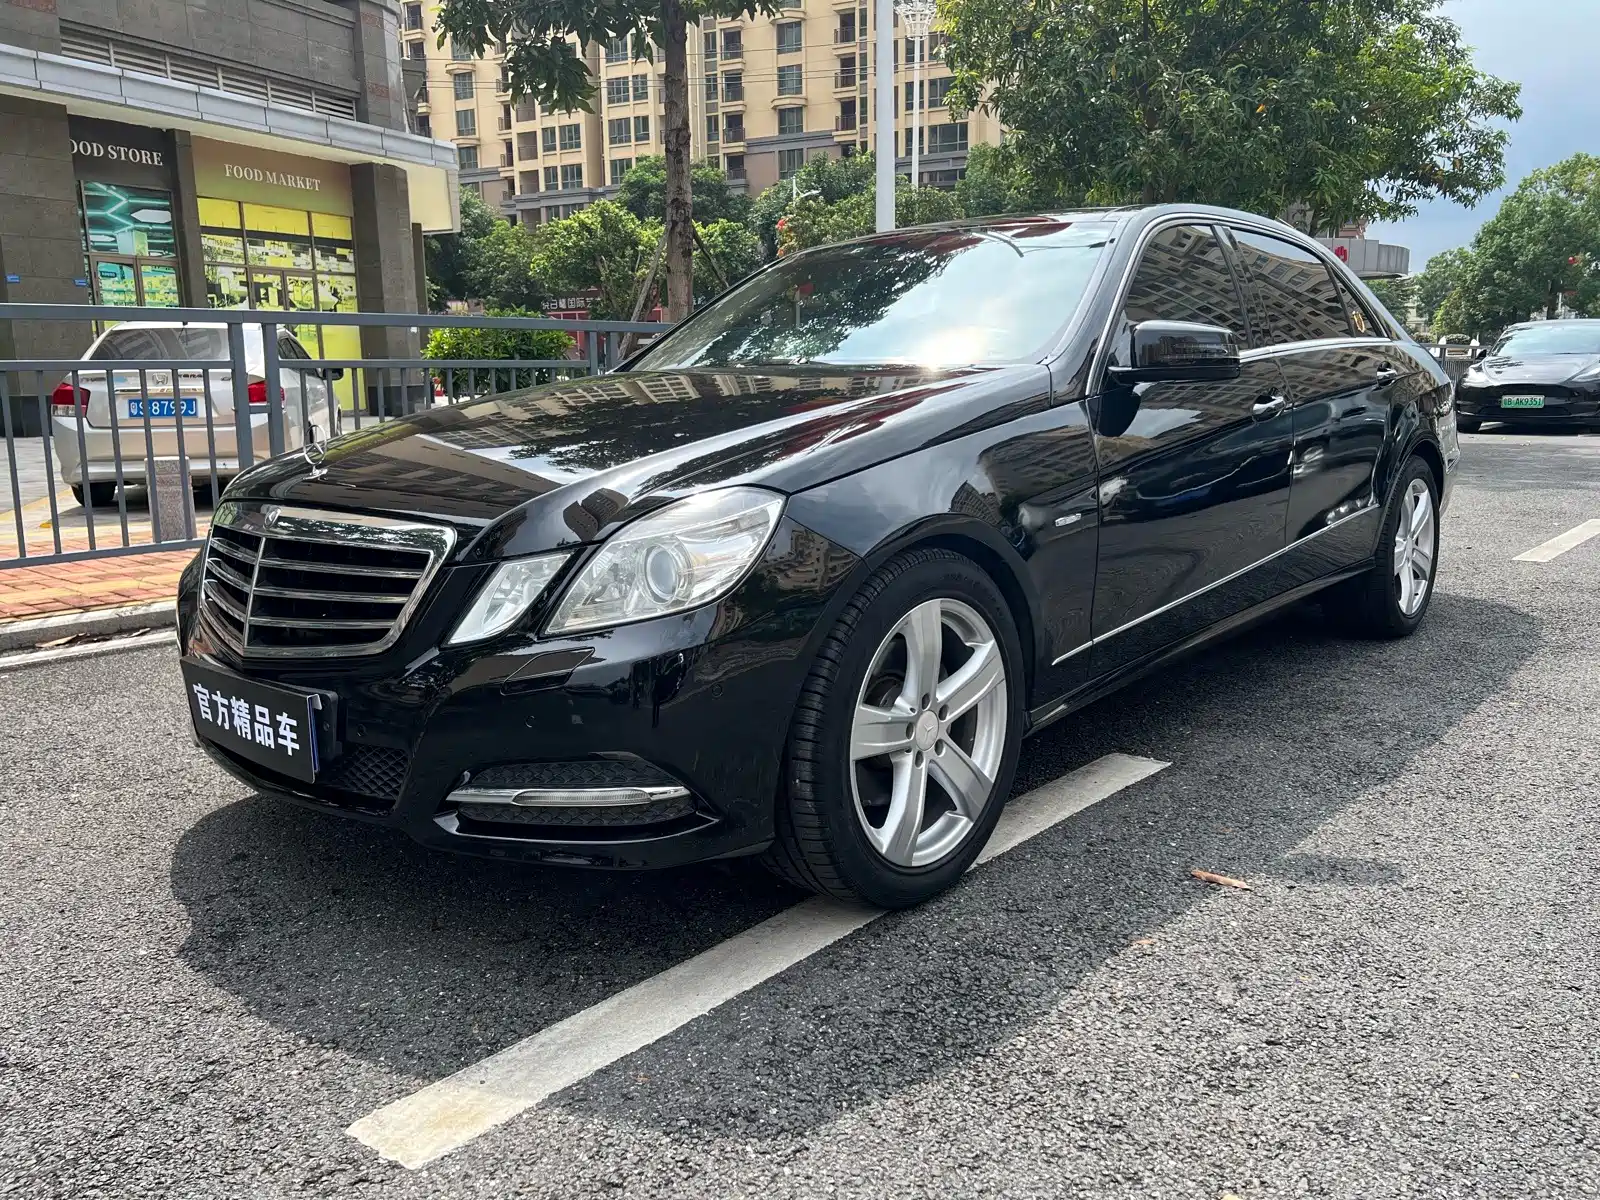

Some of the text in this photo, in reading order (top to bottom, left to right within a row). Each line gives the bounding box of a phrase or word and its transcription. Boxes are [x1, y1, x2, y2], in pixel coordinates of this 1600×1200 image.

[107, 144, 163, 166] STORE
[224, 163, 321, 191] FOOD MARKET
[192, 682, 300, 756] 官方精品车
